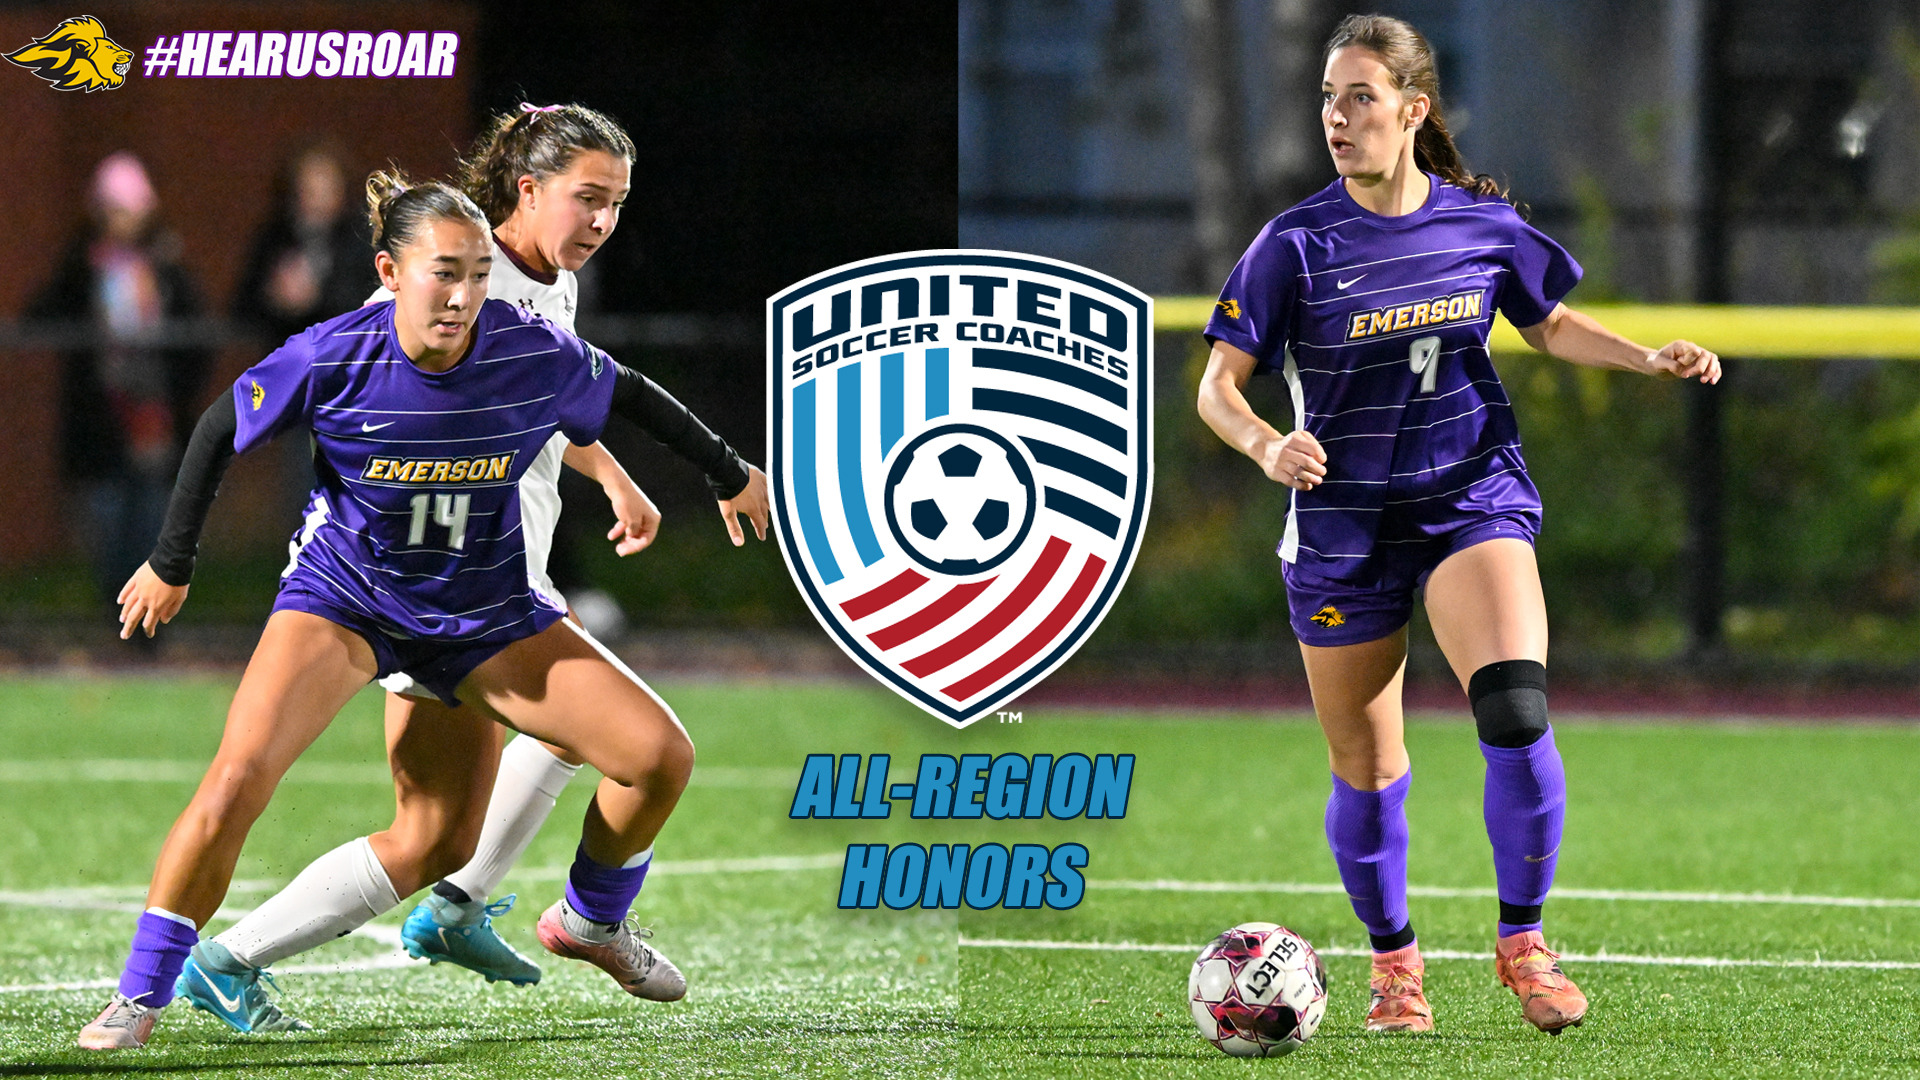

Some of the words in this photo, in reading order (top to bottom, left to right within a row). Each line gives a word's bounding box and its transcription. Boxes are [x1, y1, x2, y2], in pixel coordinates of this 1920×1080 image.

[1350, 294, 1481, 338] EMERSON
[1409, 336, 1442, 393] 9
[365, 455, 511, 482] EMERSON
[407, 494, 471, 550] 14
[1245, 937, 1298, 999] SELECT
